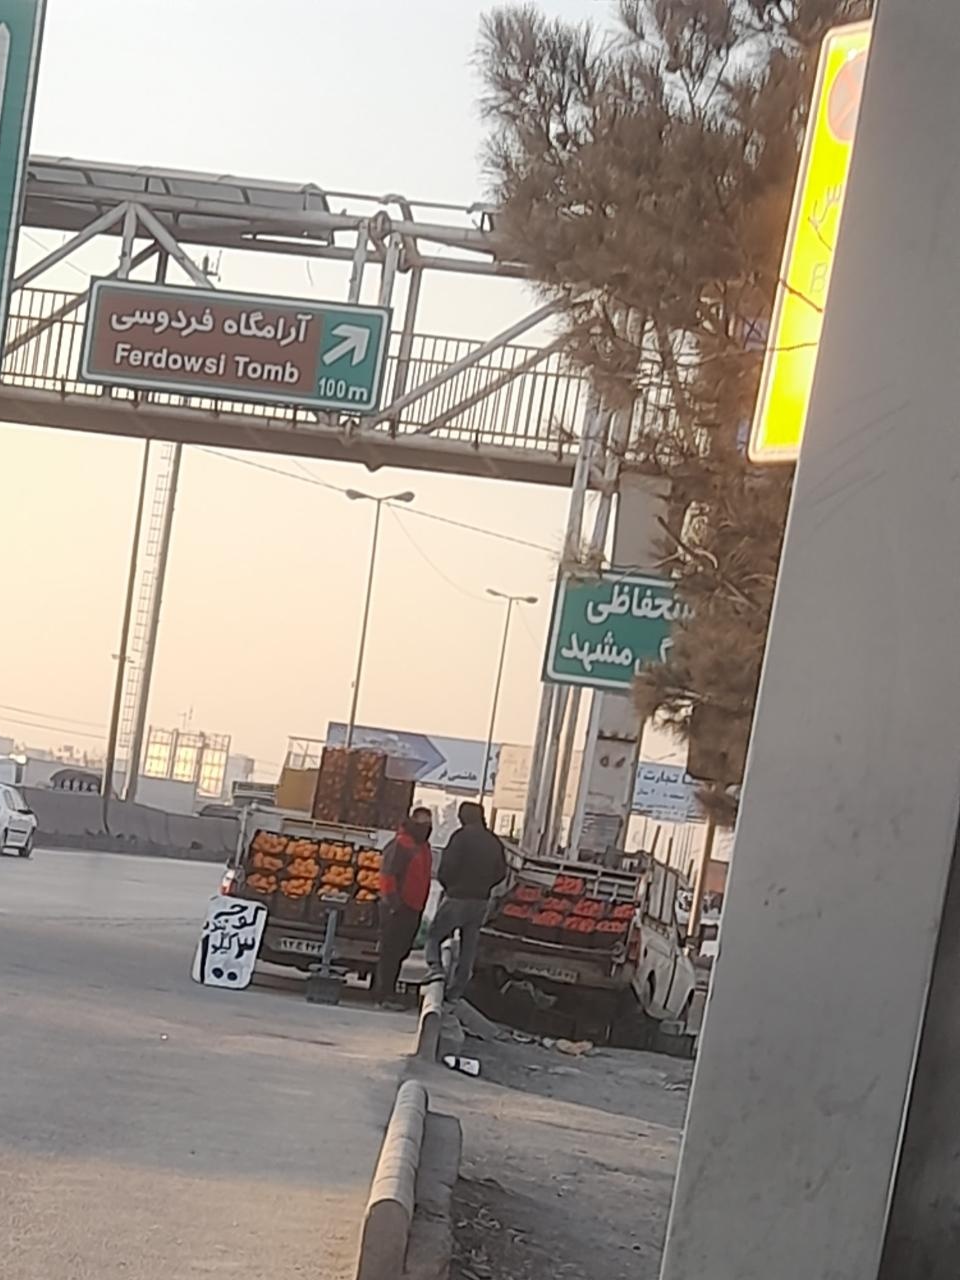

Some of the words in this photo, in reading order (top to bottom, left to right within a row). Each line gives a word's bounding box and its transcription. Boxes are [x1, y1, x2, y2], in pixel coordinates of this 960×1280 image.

[110, 306, 215, 337] فردوسی
[223, 311, 312, 347] آرامگاه
[114, 343, 227, 376] Ferdowsi
[234, 355, 300, 384] Tomb
[561, 631, 632, 672] مشهد
